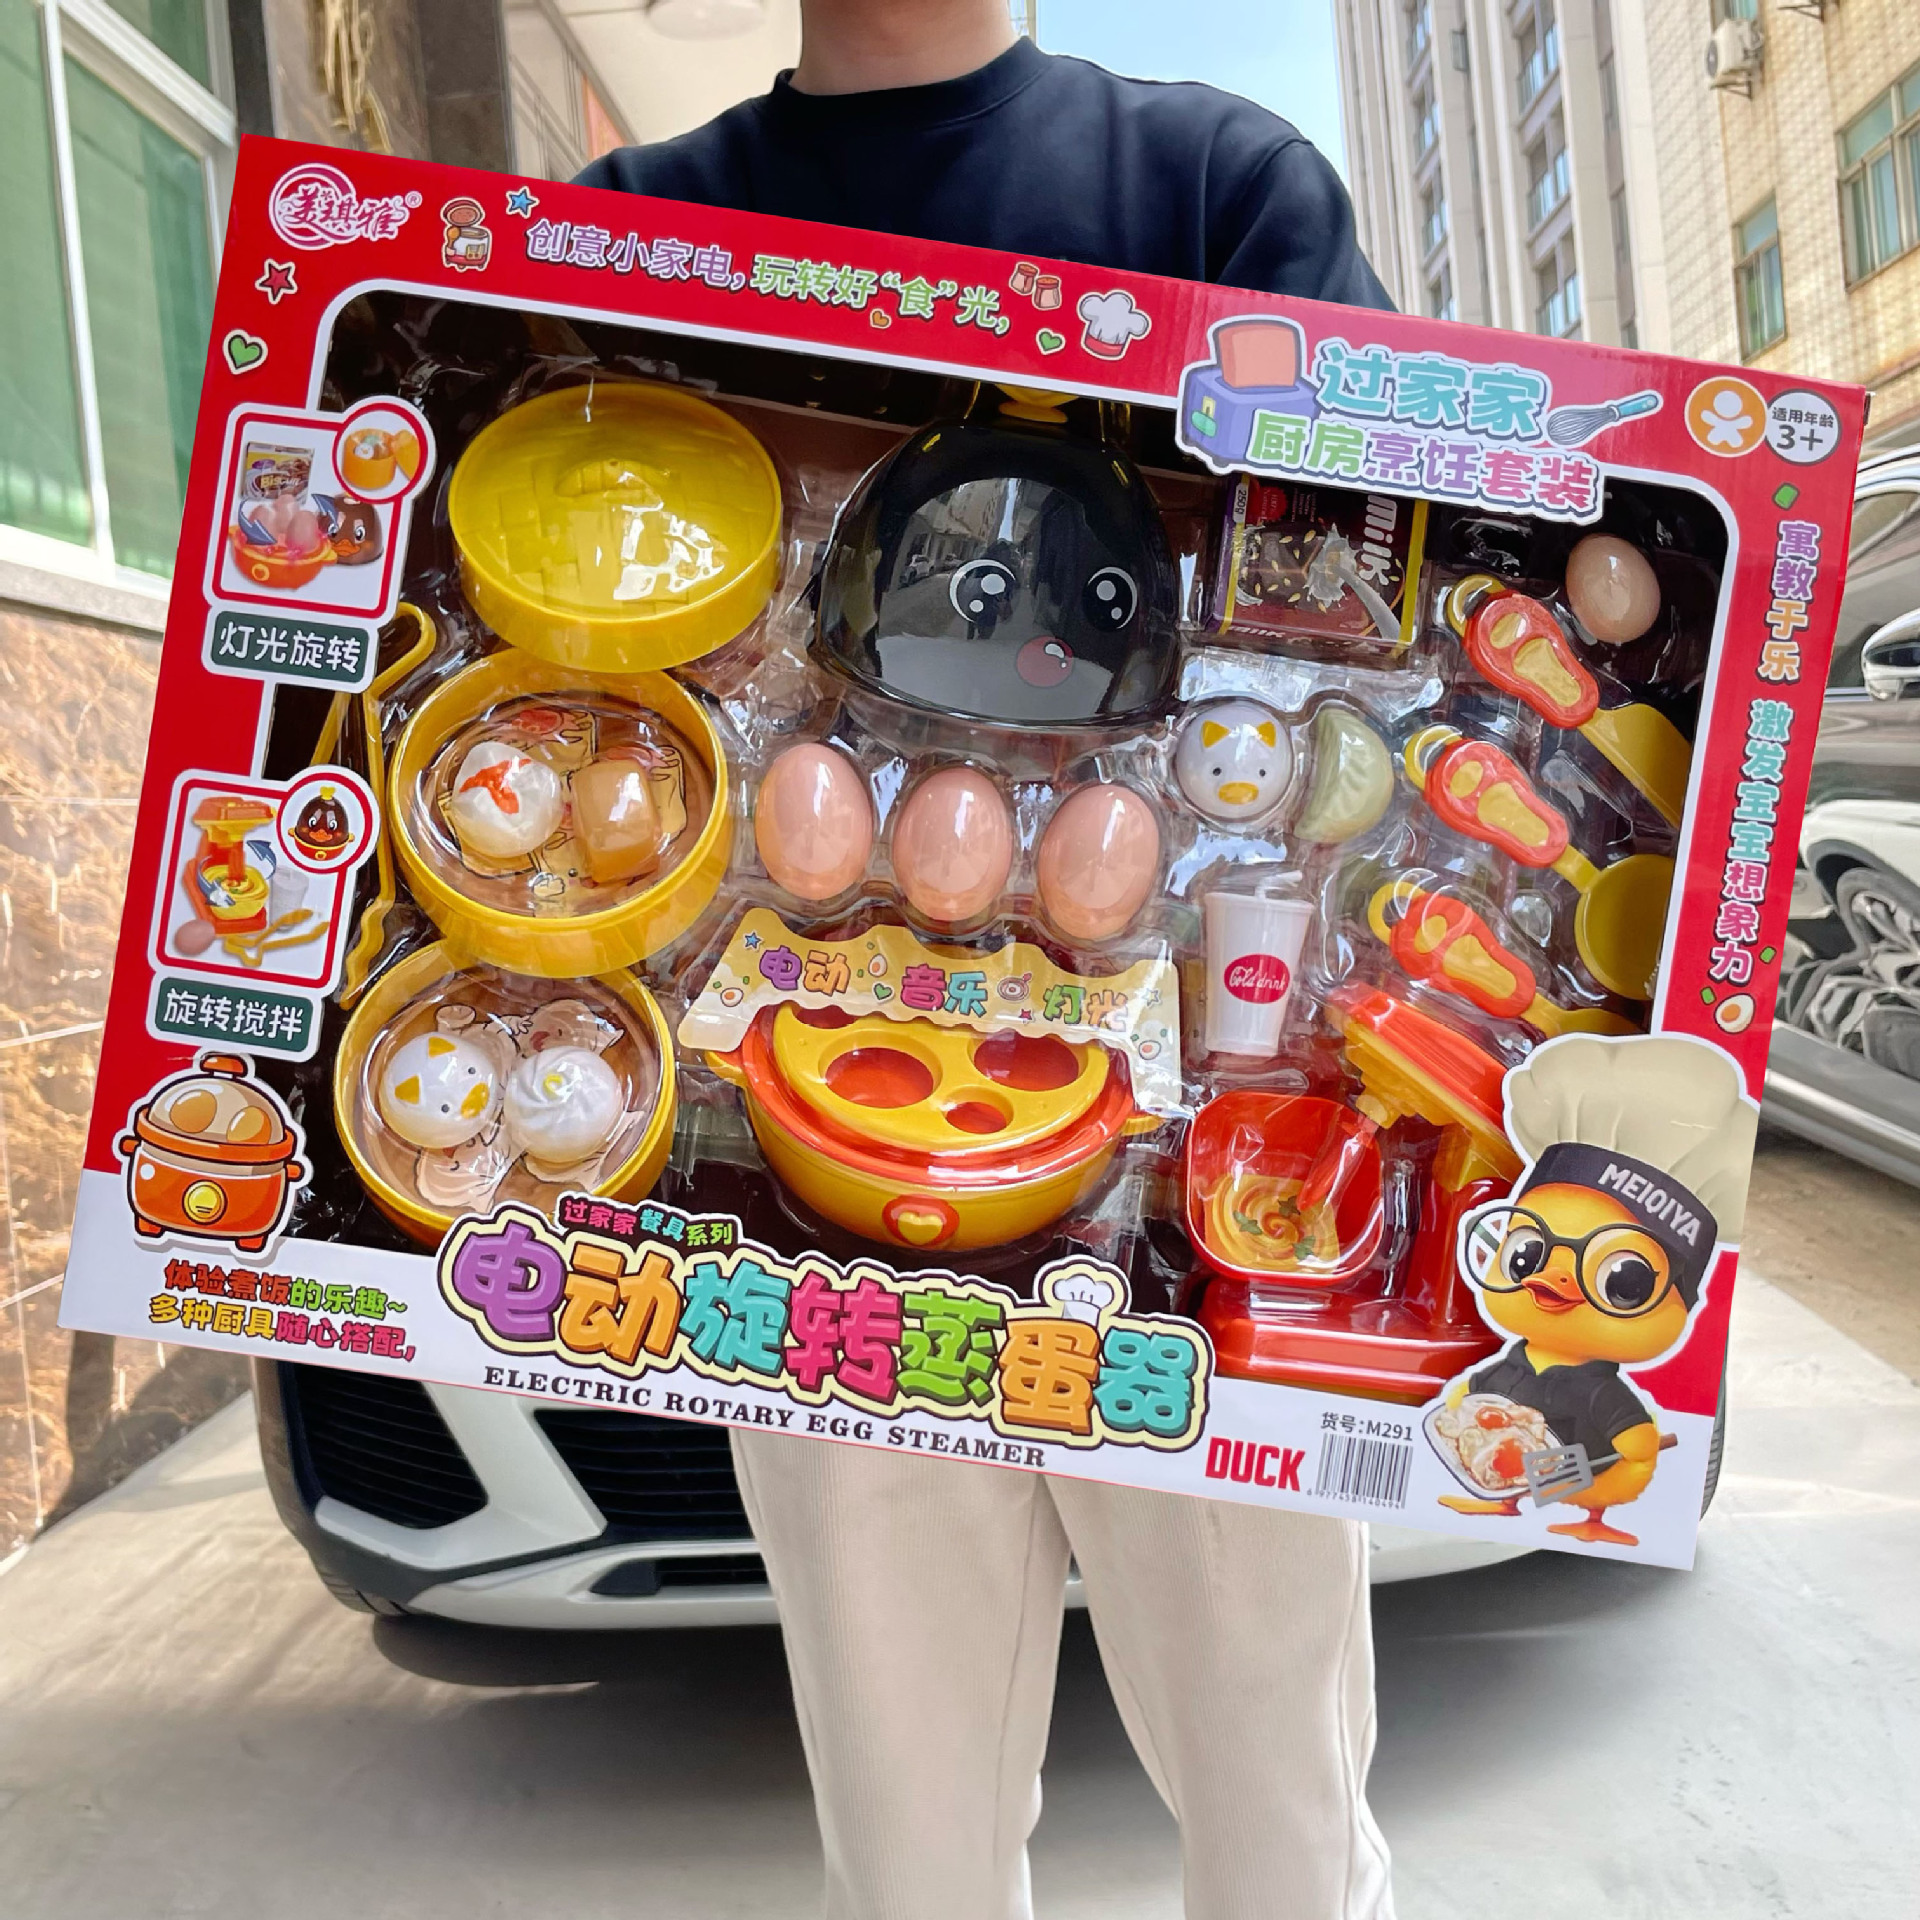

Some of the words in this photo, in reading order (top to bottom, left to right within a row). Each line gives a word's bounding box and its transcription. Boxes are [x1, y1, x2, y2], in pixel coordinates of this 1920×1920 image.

[1320, 346, 1542, 434] 过家家
[1772, 407, 1834, 428] 适用年龄
[1250, 413, 1598, 509] 厨房烹饪套装
[1776, 424, 1824, 451] 3+
[1758, 521, 1819, 681] 寓教于乐
[219, 621, 363, 673] 灯光旋转
[1710, 700, 1794, 983] 激发宝宝想象力
[163, 987, 304, 1041] 旋转搅拌
[759, 945, 852, 998] 电动
[899, 963, 989, 1018] 音乐
[1598, 1163, 1702, 1247] MEIQIYA
[453, 1222, 1198, 1434] 电动旋转蒸蛋器
[484, 1366, 652, 1409] ELECTRIC
[666, 1390, 794, 1429] ROTARY
[806, 1414, 874, 1441] EGG
[887, 1426, 1047, 1468] STEAMER
[1205, 1437, 1305, 1491] DUCK
